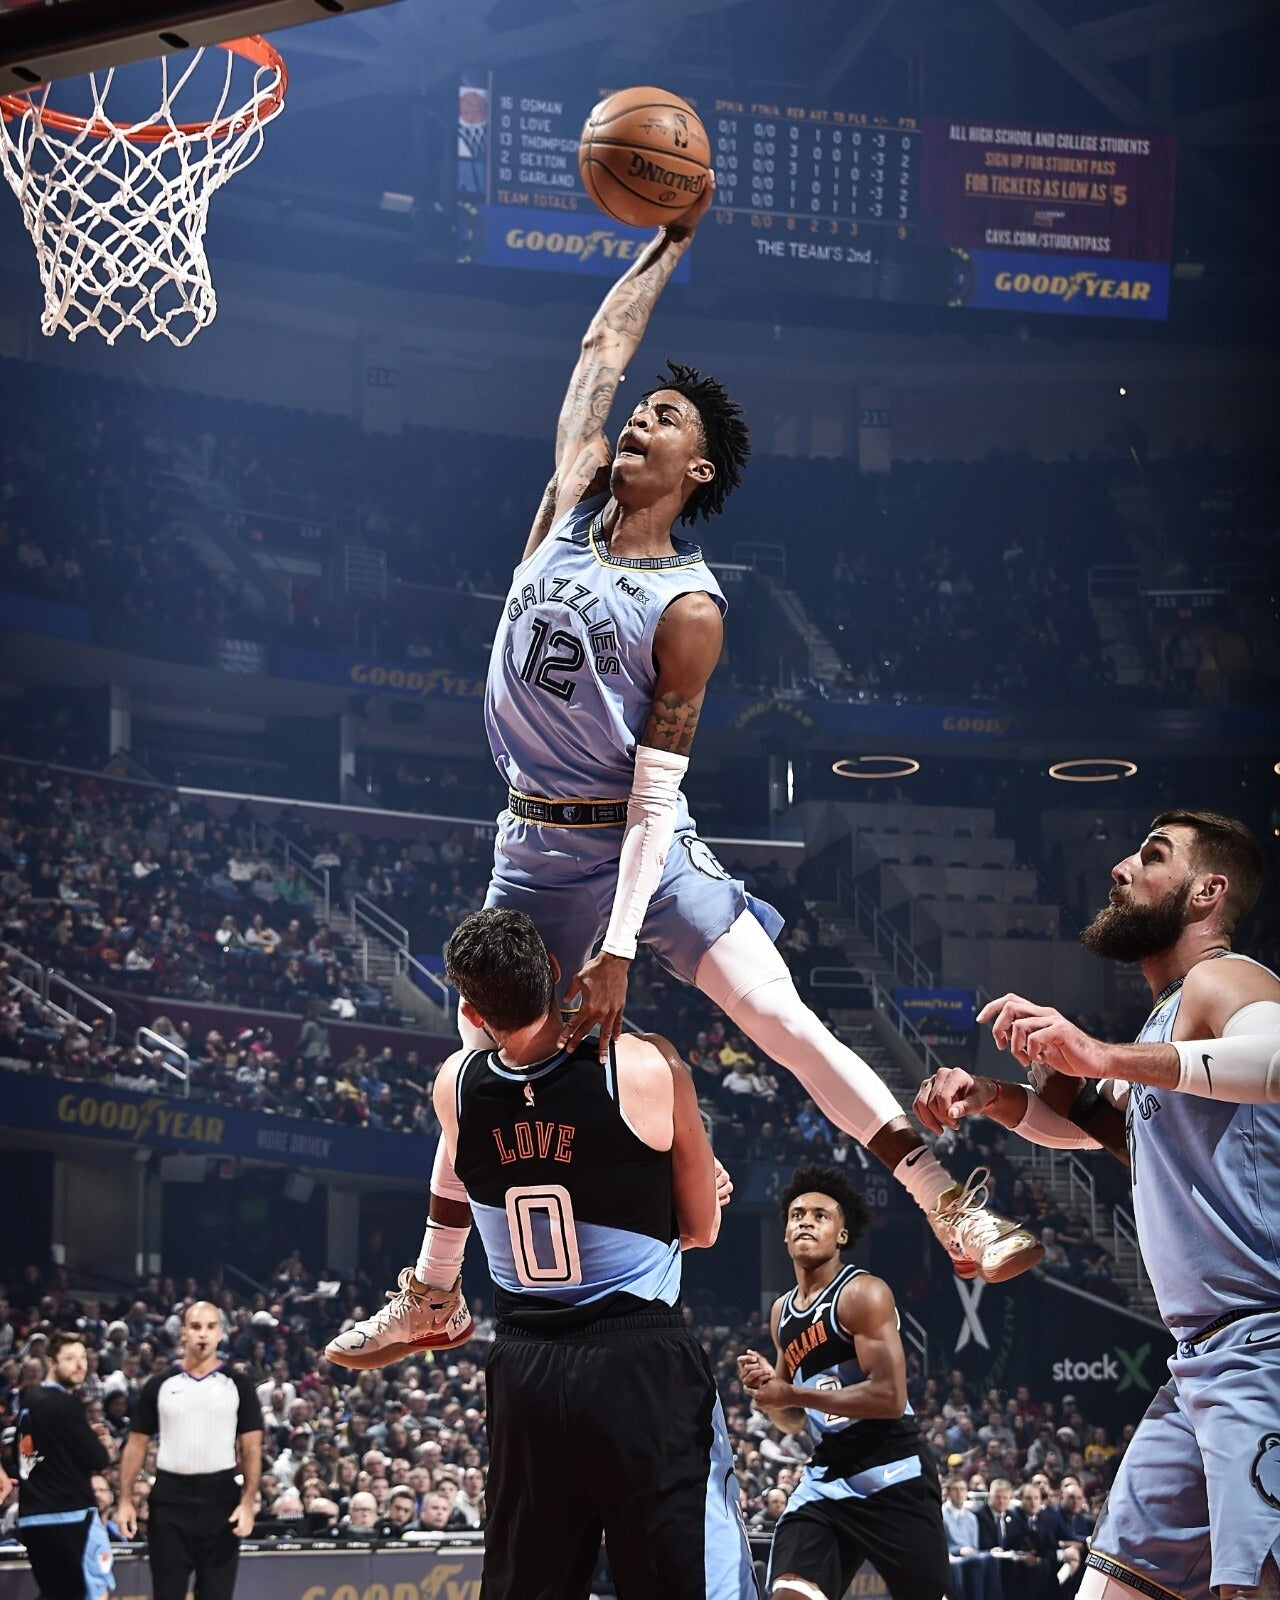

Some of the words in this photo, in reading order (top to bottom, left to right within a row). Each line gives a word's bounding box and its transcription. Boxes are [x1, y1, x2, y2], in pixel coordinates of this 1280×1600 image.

[520, 97, 562, 114] OSMAN
[520, 117, 552, 133] LOVE
[521, 135, 579, 153] THOMPSO
[950, 125, 967, 141] ALL
[969, 126, 994, 144] HIGH
[995, 128, 1032, 147] SCHOOL
[1034, 132, 1055, 148] AND
[1057, 134, 1098, 152] COLLEGE
[1099, 137, 1150, 155] STUDENTS
[520, 153, 566, 169] SEXTON
[628, 150, 706, 195] SPALDING
[985, 152, 1009, 167] SIGN
[1011, 154, 1023, 168] UP
[1025, 155, 1043, 170] FOR
[1045, 156, 1088, 173] STUDENT
[1091, 160, 1115, 176] PASS
[518, 170, 575, 188] GARLAND
[965, 173, 989, 191] FOR
[991, 175, 1041, 196] TICKETS
[1043, 179, 1059, 197] AS
[1061, 180, 1087, 199] LOW
[1090, 184, 1106, 201] AS
[498, 190, 529, 204] TEAM
[533, 193, 578, 210] TOTALS
[506, 229, 650, 261] GOODYEA
[757, 239, 785, 256] THE
[847, 248, 872, 264] 2nd
[985, 229, 1111, 252] CAVS.COM/STUDENTPASS
[995, 272, 1150, 300] GOODYEAR
[615, 575, 650, 606] FedEx
[508, 577, 620, 675] GRIZZLIES
[520, 617, 585, 702] 12
[351, 664, 485, 697] GOODYEA
[57, 1094, 225, 1144] GOODYEAR
[492, 1121, 576, 1165] LOVE
[505, 1184, 582, 1287] 0
[1052, 1342, 1151, 1393] stockX
